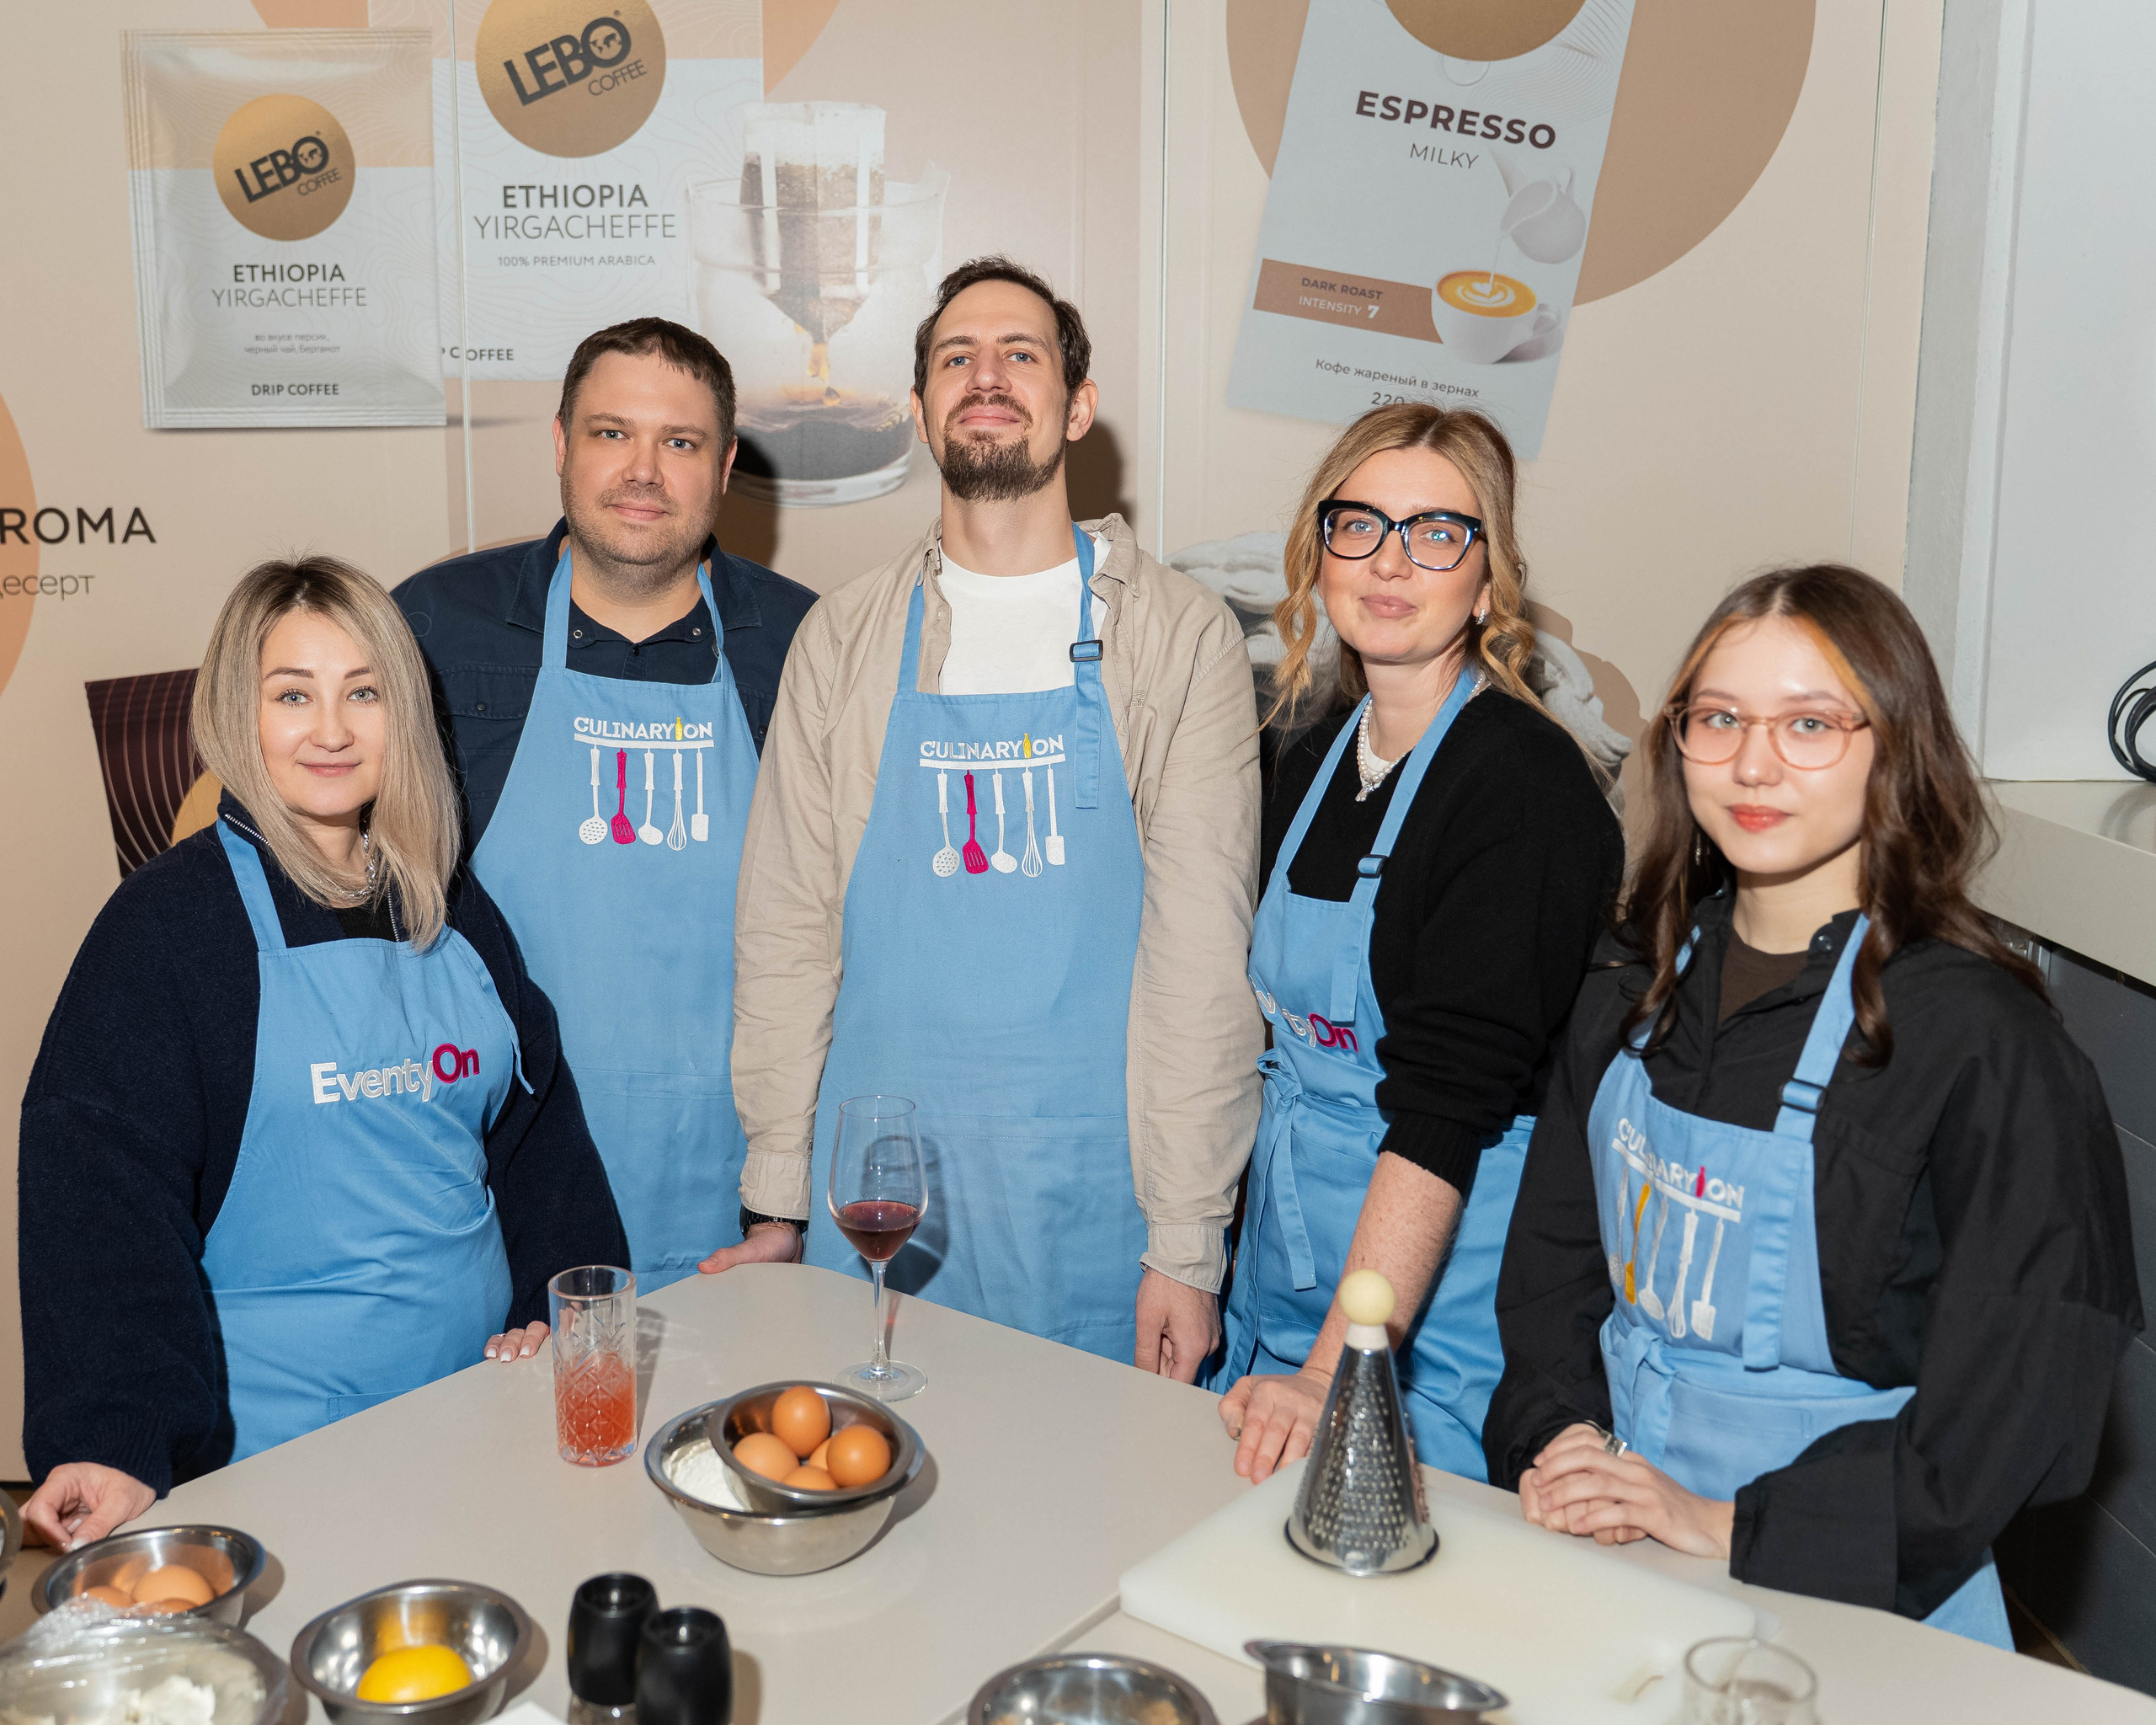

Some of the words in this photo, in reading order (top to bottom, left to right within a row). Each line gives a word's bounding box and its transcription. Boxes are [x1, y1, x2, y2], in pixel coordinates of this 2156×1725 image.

[504, 17, 632, 106] LEBO
[588, 59, 648, 96] COFFEE
[1355, 90, 1556, 149] ESPRESSO
[1409, 142, 1479, 169] MILKY
[234, 136, 329, 203] LEBO
[296, 168, 342, 196] COFFEE
[503, 184, 648, 208] ETHIOPIA
[473, 214, 677, 239] YIRGACHEFFE
[233, 264, 345, 283] ETHIOPIA
[498, 256, 531, 267] 100%
[533, 255, 595, 266] PREMIUM
[598, 255, 656, 266] ARABICA
[211, 287, 368, 308] YIRGACHEFFE
[1301, 277, 1337, 292] DARK
[1340, 285, 1384, 301] ROAST
[1298, 296, 1363, 316] INTENSITY
[1367, 304, 1380, 319] 7
[252, 384, 284, 396] DRIP
[287, 384, 340, 396] COFFEE
[1315, 359, 1351, 375] Кофе
[1353, 367, 1417, 387] жареный
[1420, 379, 1429, 388] в
[1432, 382, 1480, 398] зернах
[0, 507, 157, 545] ROMA
[0, 574, 95, 601] есерт
